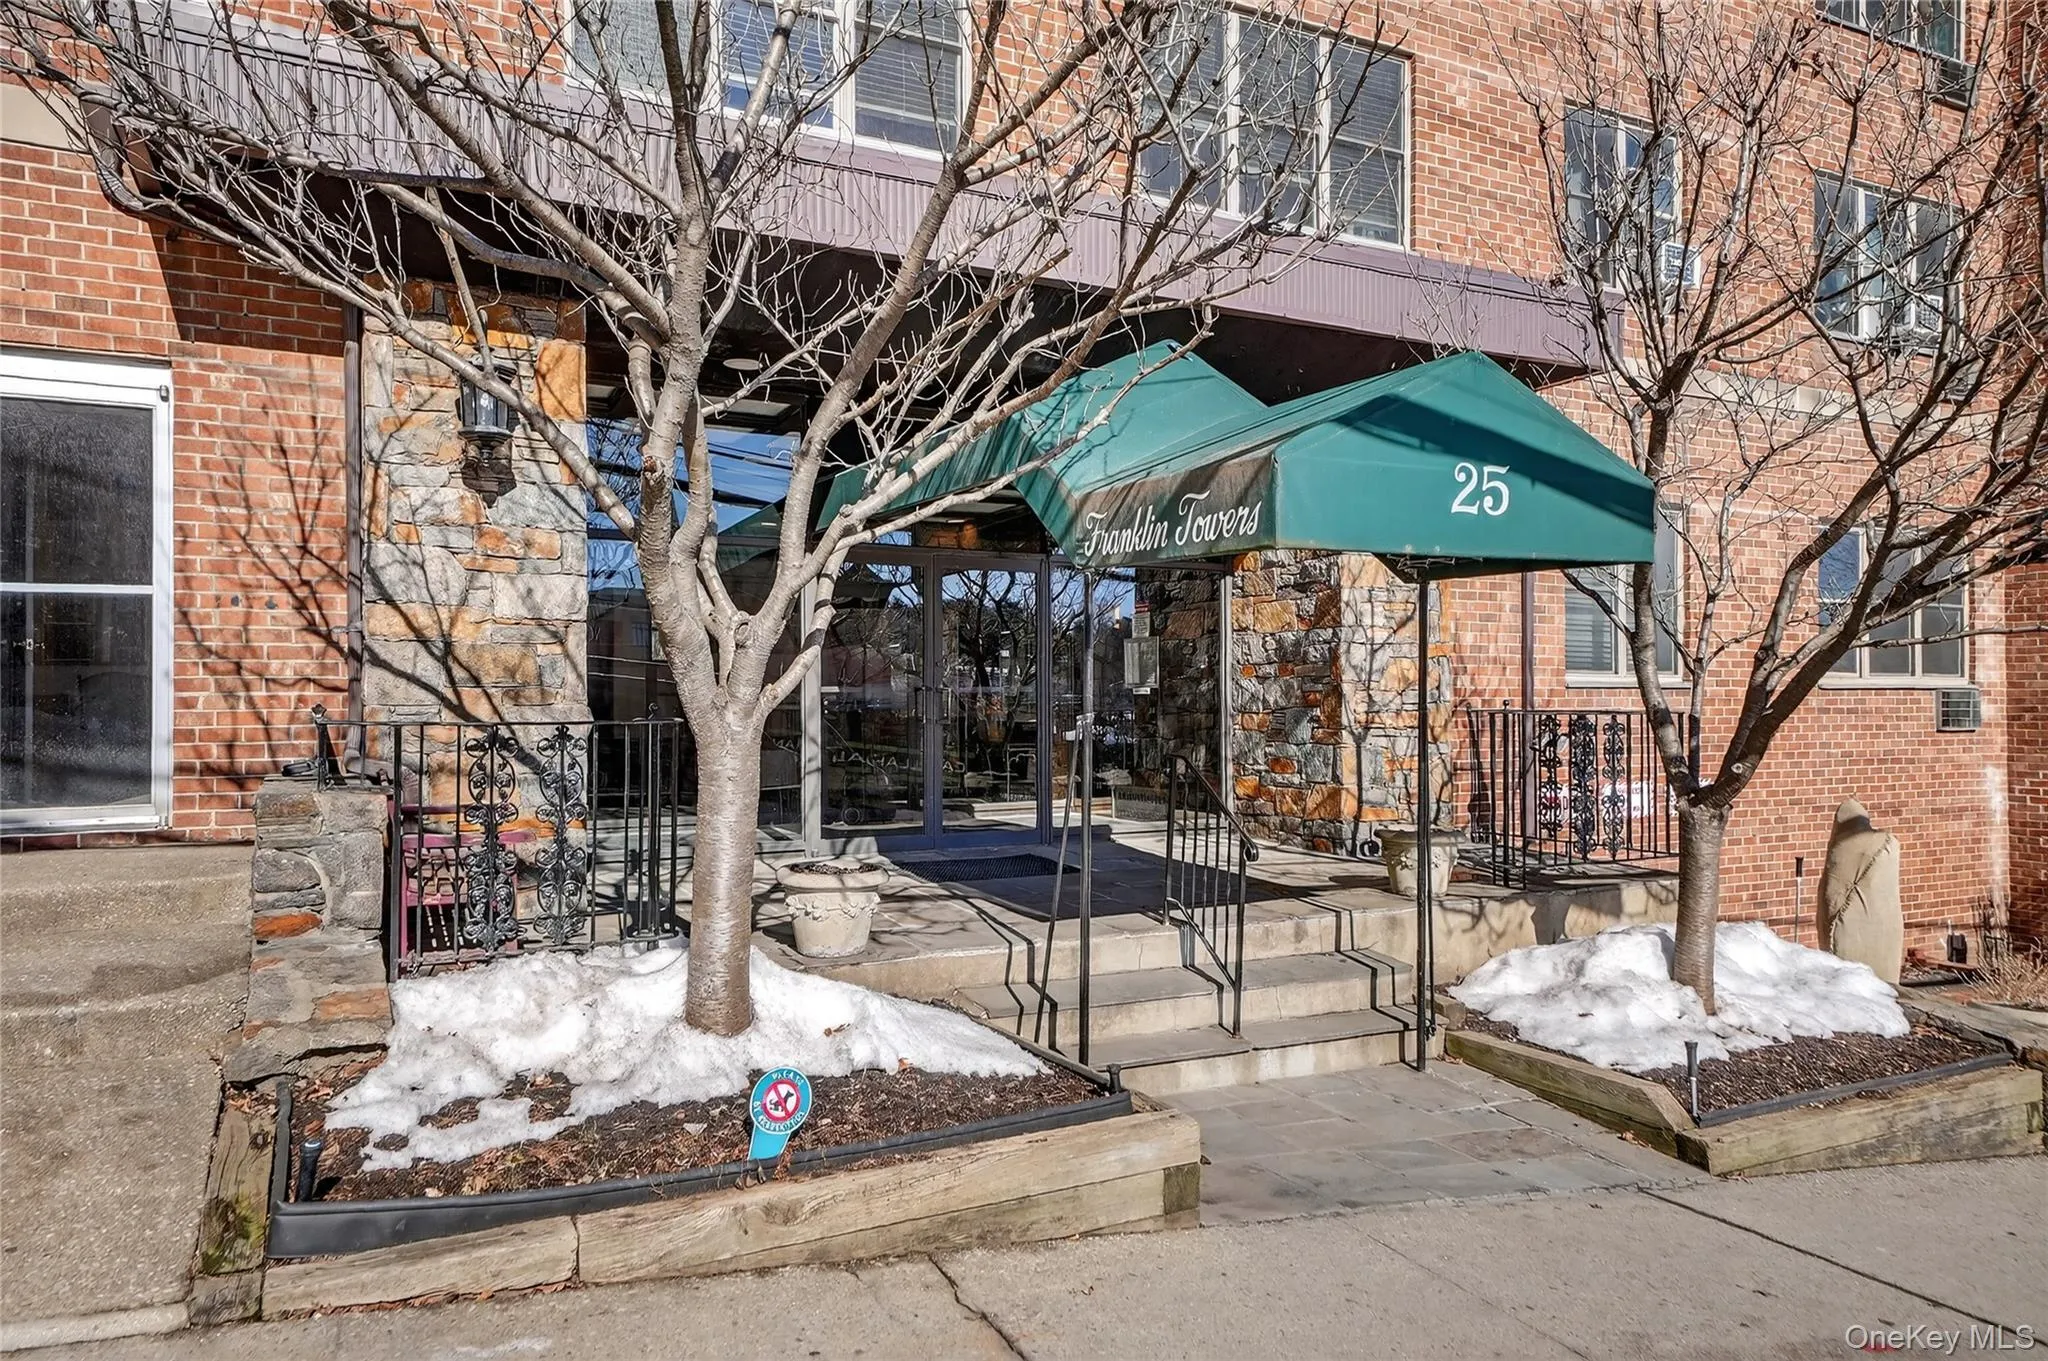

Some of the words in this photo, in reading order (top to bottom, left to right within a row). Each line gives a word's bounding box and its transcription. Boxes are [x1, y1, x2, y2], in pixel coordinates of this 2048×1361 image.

[1451, 462, 1511, 516] 25
[1084, 504, 1169, 557] Franklin
[1175, 490, 1263, 546] Towers
